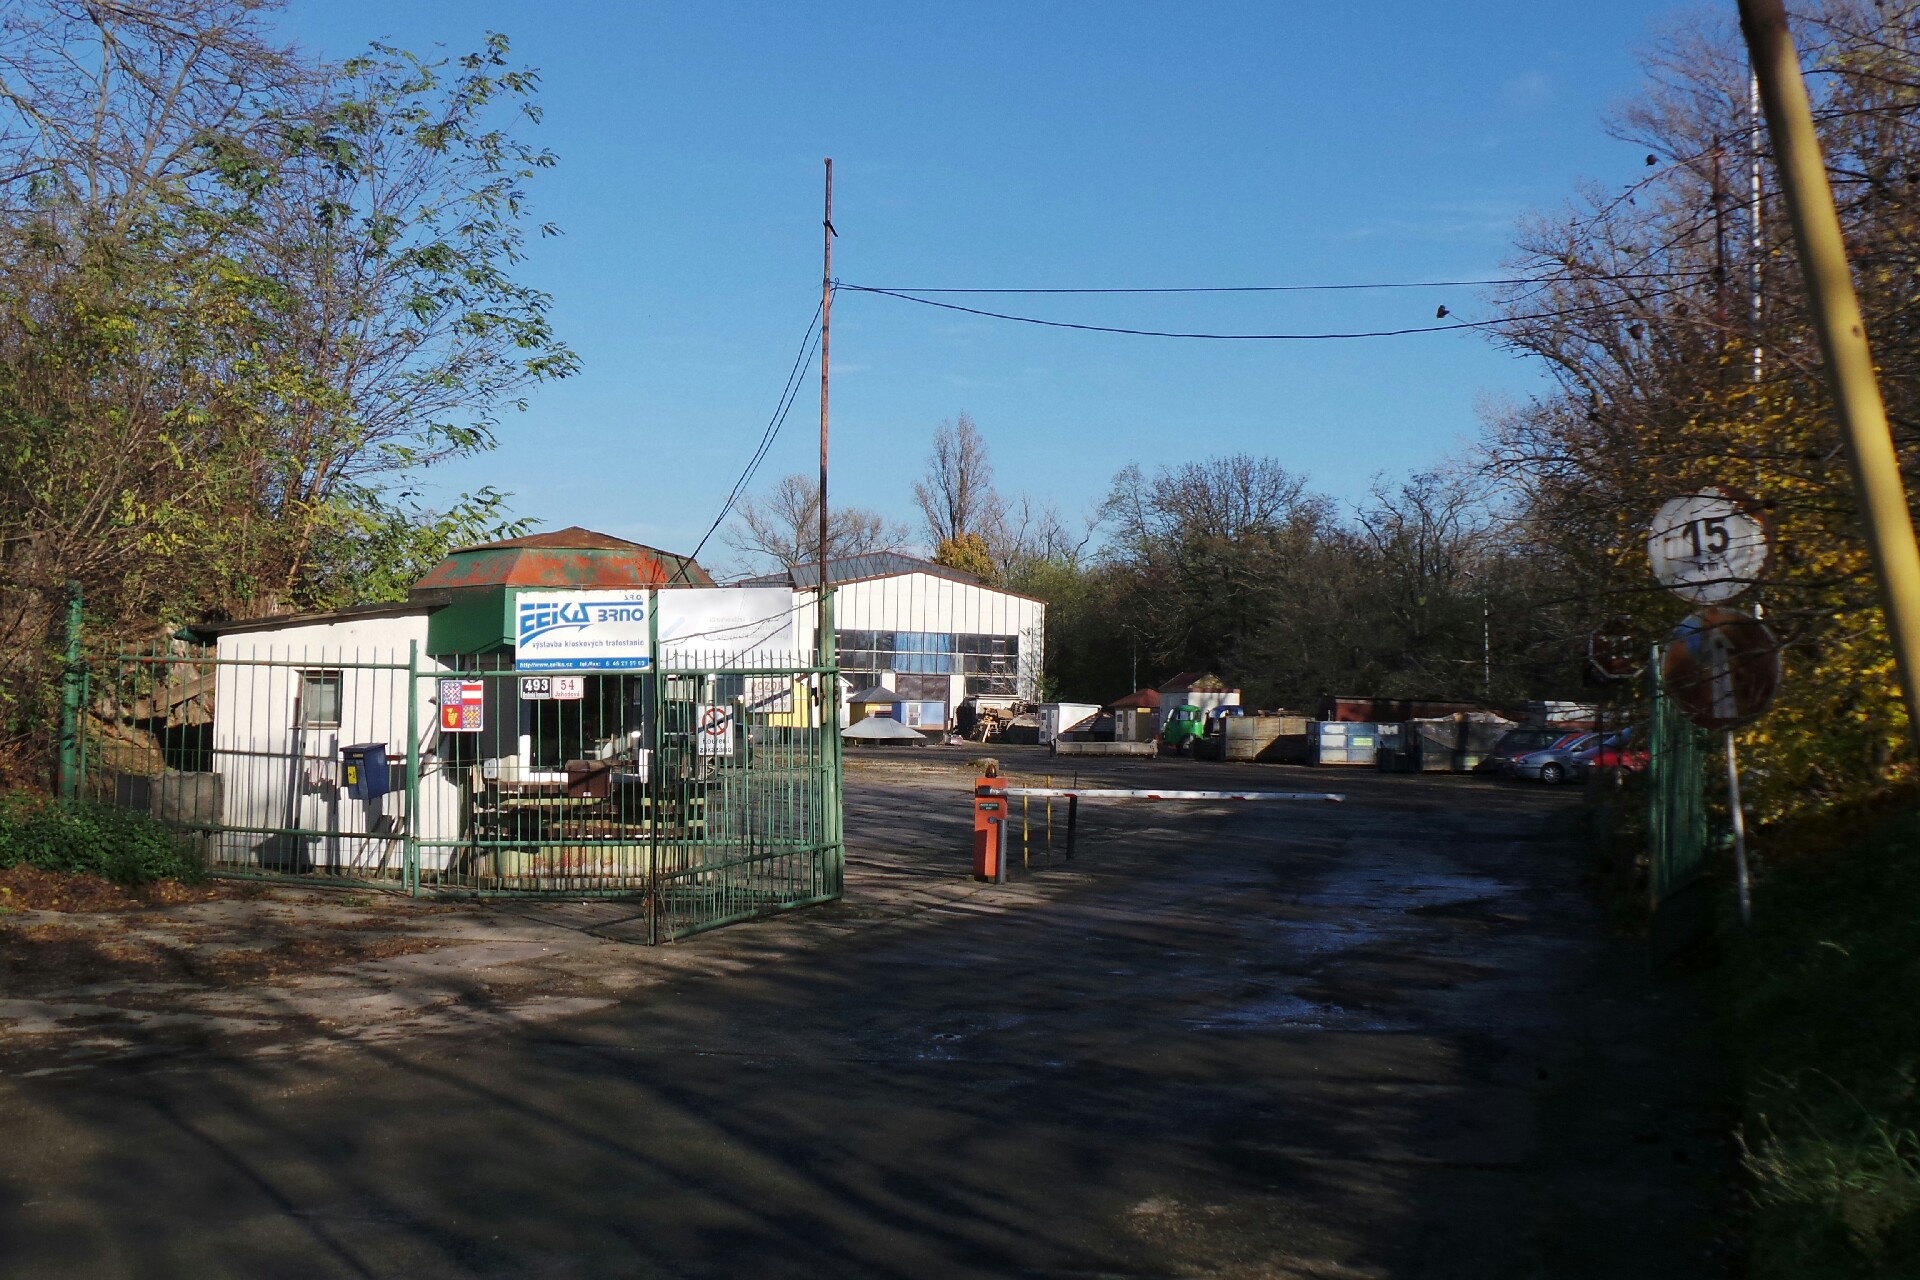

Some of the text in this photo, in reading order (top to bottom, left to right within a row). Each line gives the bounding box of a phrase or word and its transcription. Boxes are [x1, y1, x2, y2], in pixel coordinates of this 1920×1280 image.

[1682, 519, 1730, 557] 15
[598, 608, 644, 622] BRNO
[532, 637, 645, 649] výstavba kioskových trafostanic
[525, 679, 549, 691] 493
[560, 679, 575, 691] 54
